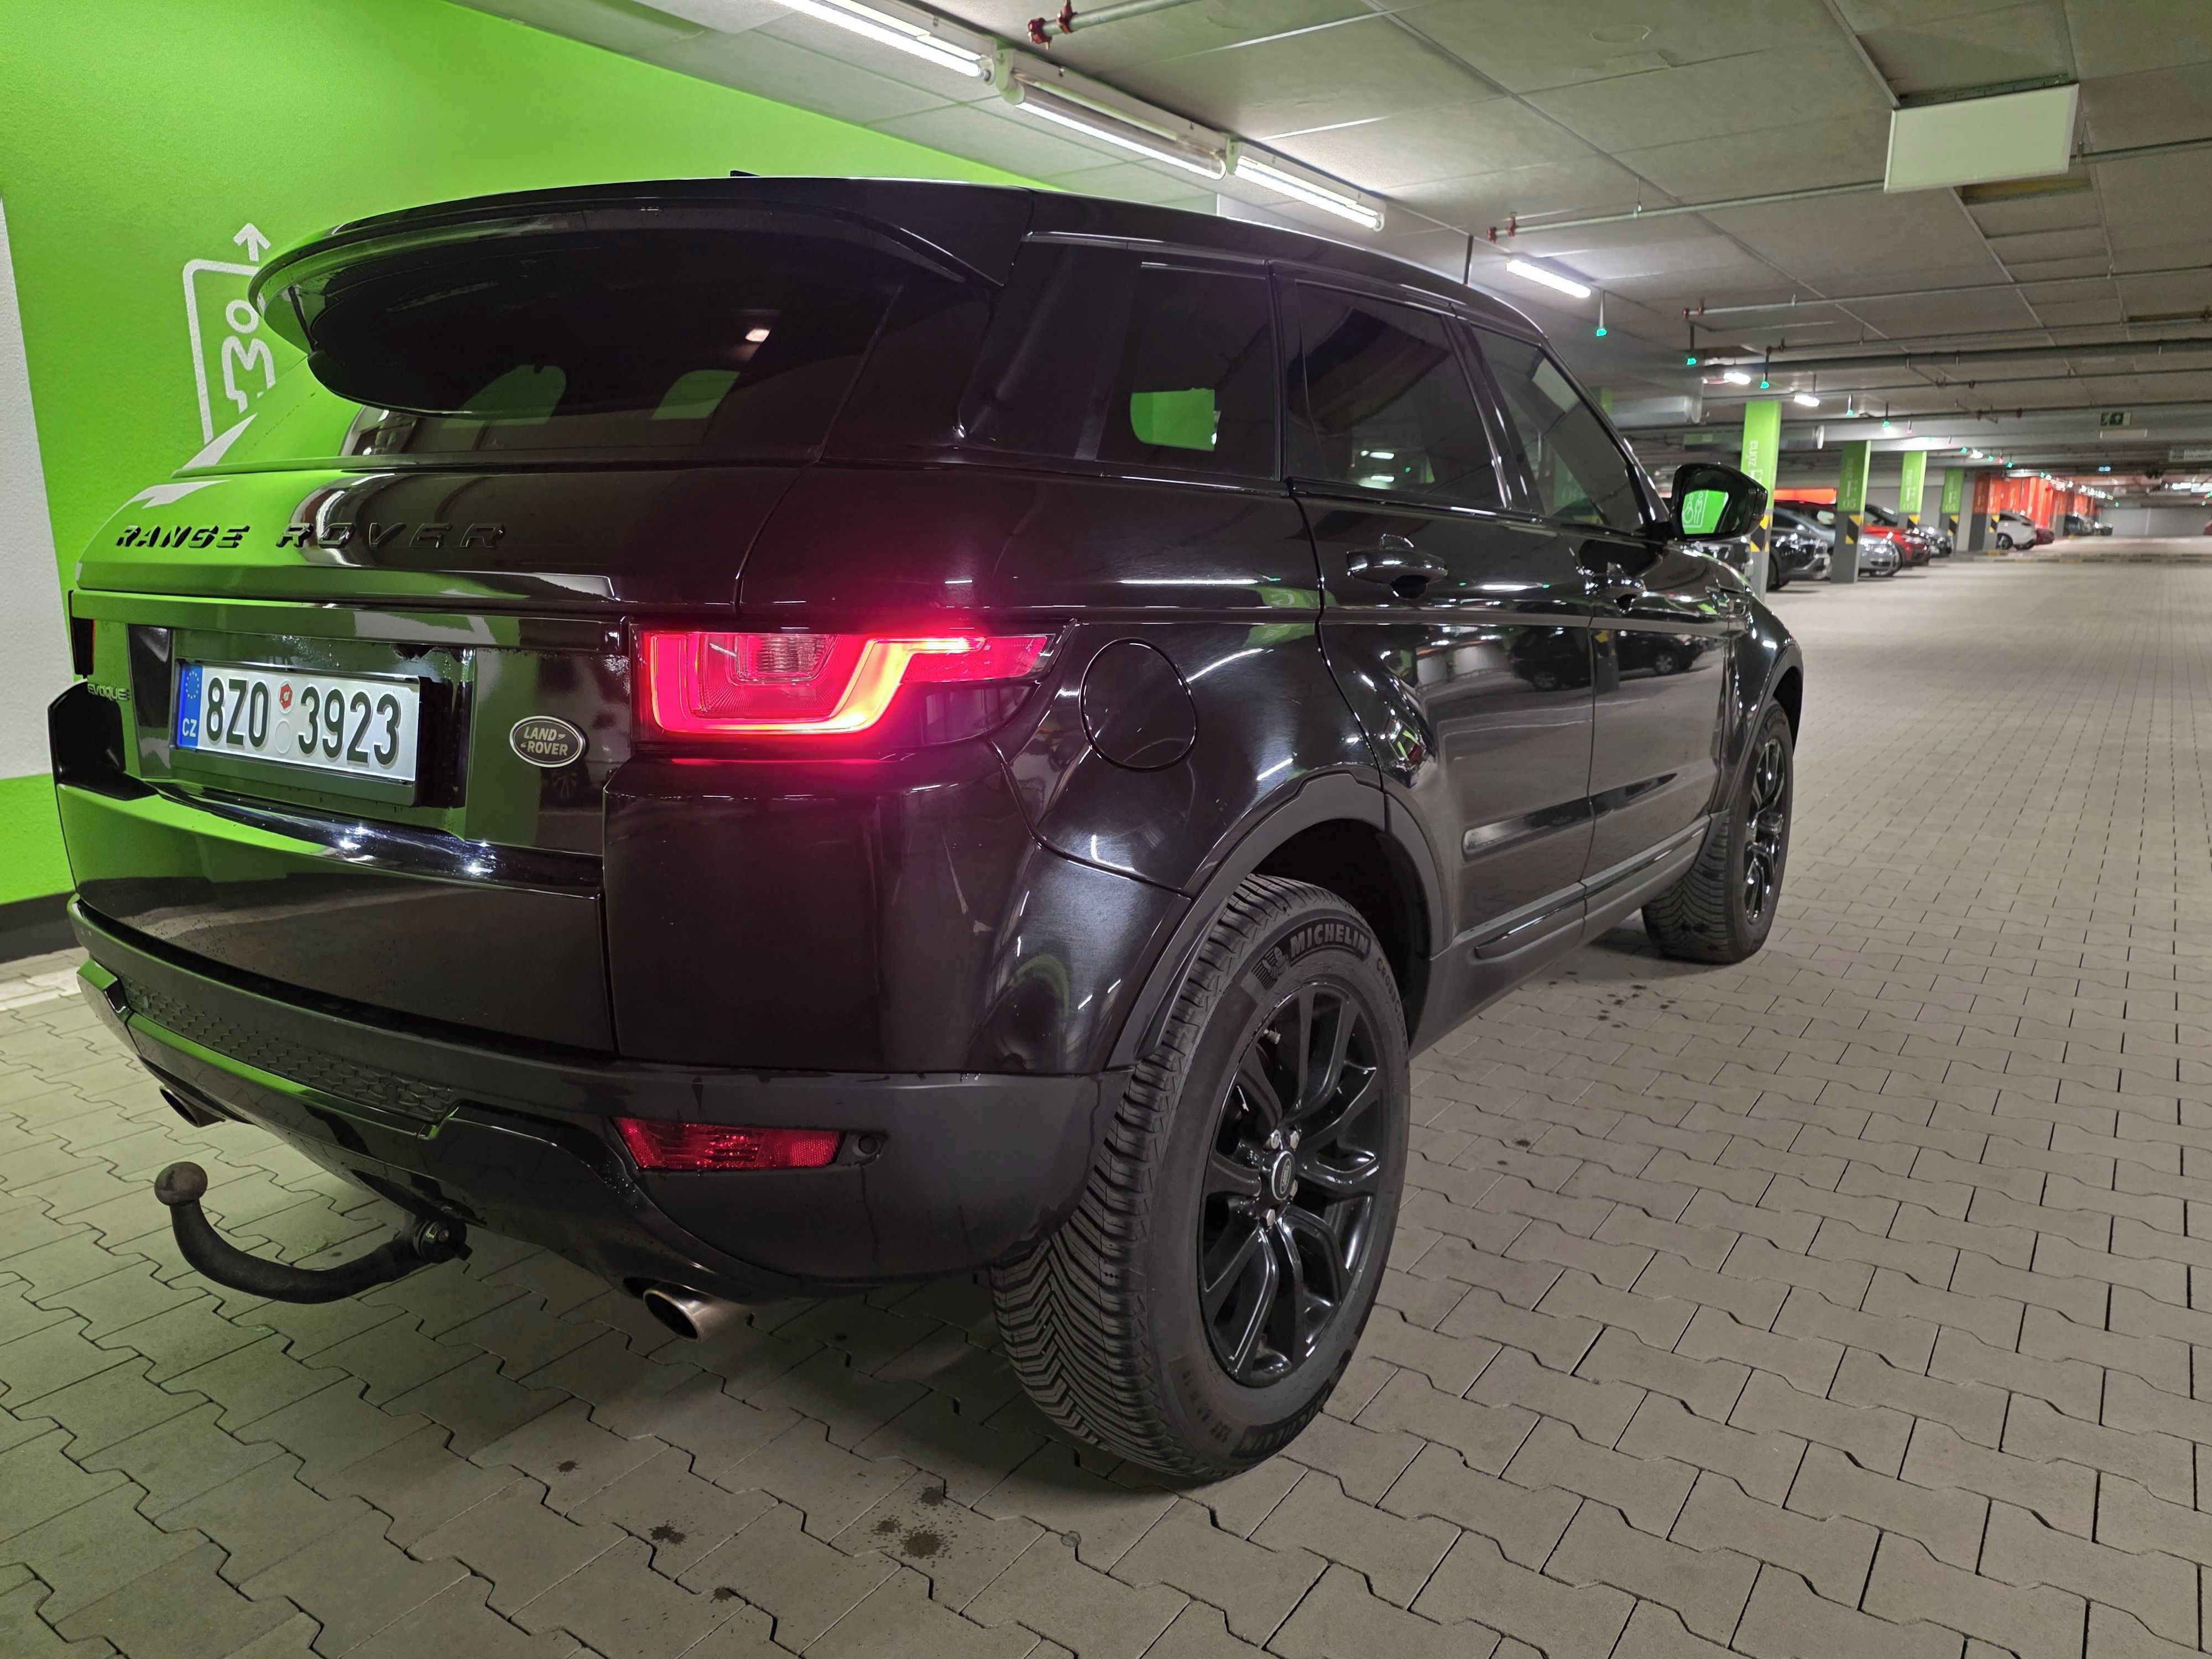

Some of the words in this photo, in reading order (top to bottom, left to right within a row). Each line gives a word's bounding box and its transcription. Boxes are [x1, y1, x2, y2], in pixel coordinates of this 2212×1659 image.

[115, 524, 251, 549] RANGE
[276, 522, 506, 550] ROVER
[87, 683, 129, 701] EVOQUE
[182, 718, 197, 737] CZ
[298, 686, 400, 765] 3923
[524, 727, 557, 741] LAND
[527, 740, 568, 756] ROVER
[1290, 923, 1369, 958] MICHELIN
